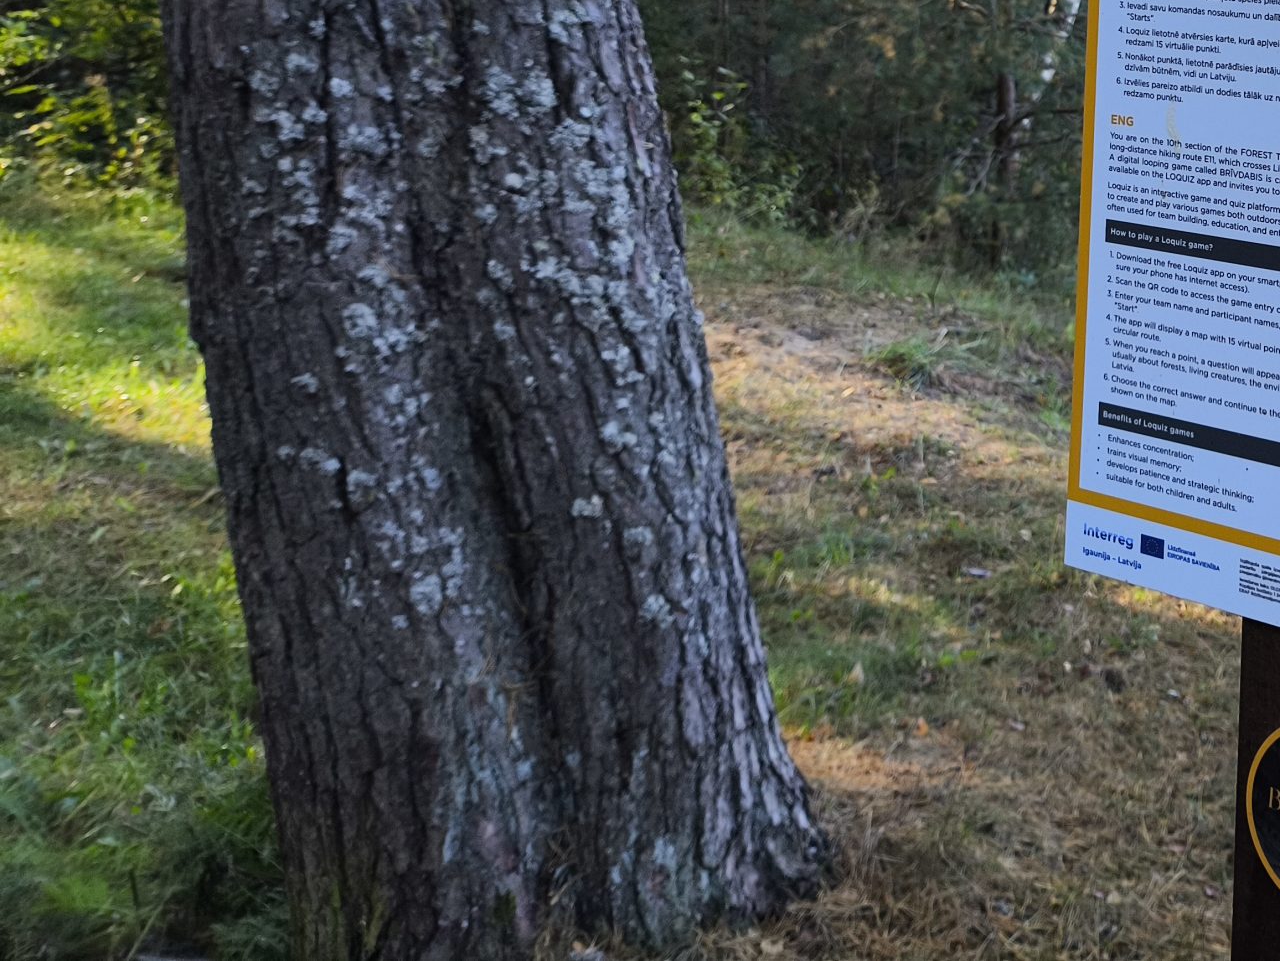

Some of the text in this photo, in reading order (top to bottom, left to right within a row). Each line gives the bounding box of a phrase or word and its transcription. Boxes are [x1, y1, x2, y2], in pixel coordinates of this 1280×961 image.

[1110, 114, 1134, 127] ENG
[1109, 131, 1124, 141] You
[1125, 134, 1138, 143] are
[1139, 136, 1150, 144] on
[1151, 137, 1164, 146] the
[1166, 138, 1183, 148] 10th
[1184, 142, 1212, 152] section
[1213, 145, 1223, 154] of
[1224, 146, 1239, 156] the
[1240, 147, 1273, 160] FOREST
[1110, 227, 1127, 237] How
[1128, 230, 1137, 239] to
[1137, 232, 1154, 243] play
[1161, 235, 1187, 248] Loquiz
[1187, 241, 1214, 252] game?
[1102, 409, 1195, 439] Benefits of Loquiz games
[1106, 446, 1182, 473] trains visual memory;
[1107, 433, 1195, 463] Enhances concentration;
[1083, 523, 1134, 551] Interreg
[1082, 546, 1111, 562] Igaunija
[1117, 555, 1142, 570] Latvija
